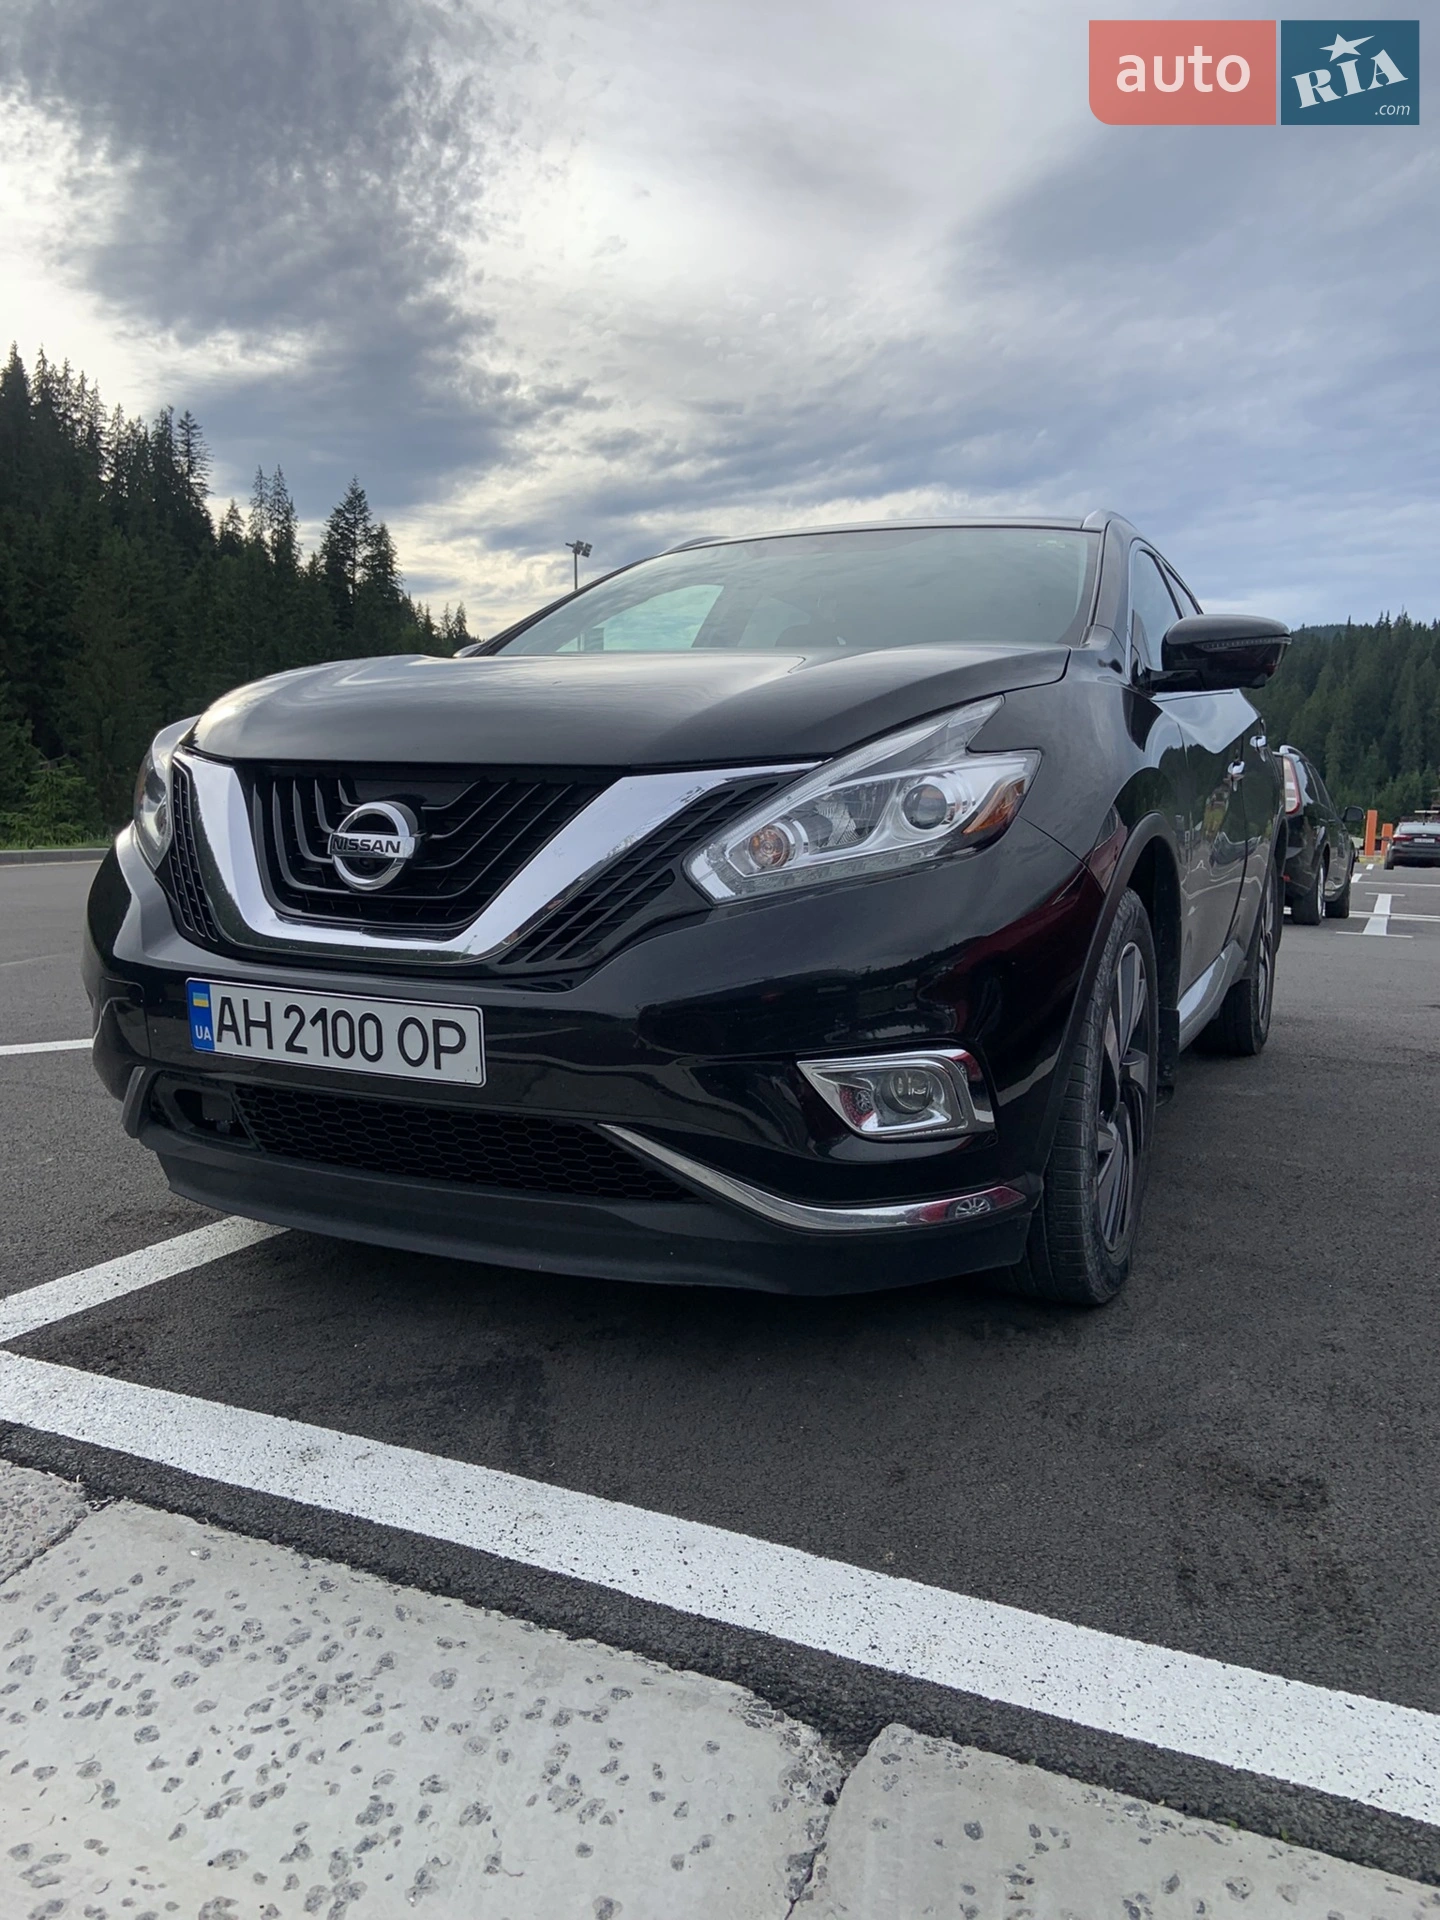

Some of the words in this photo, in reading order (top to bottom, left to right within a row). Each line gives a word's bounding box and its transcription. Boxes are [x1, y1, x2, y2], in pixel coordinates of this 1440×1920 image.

[332, 836, 401, 854] NISSAN
[195, 1024, 212, 1041] UA
[216, 996, 274, 1050] AH
[283, 1004, 384, 1063] 2100
[397, 1016, 467, 1070] OP
